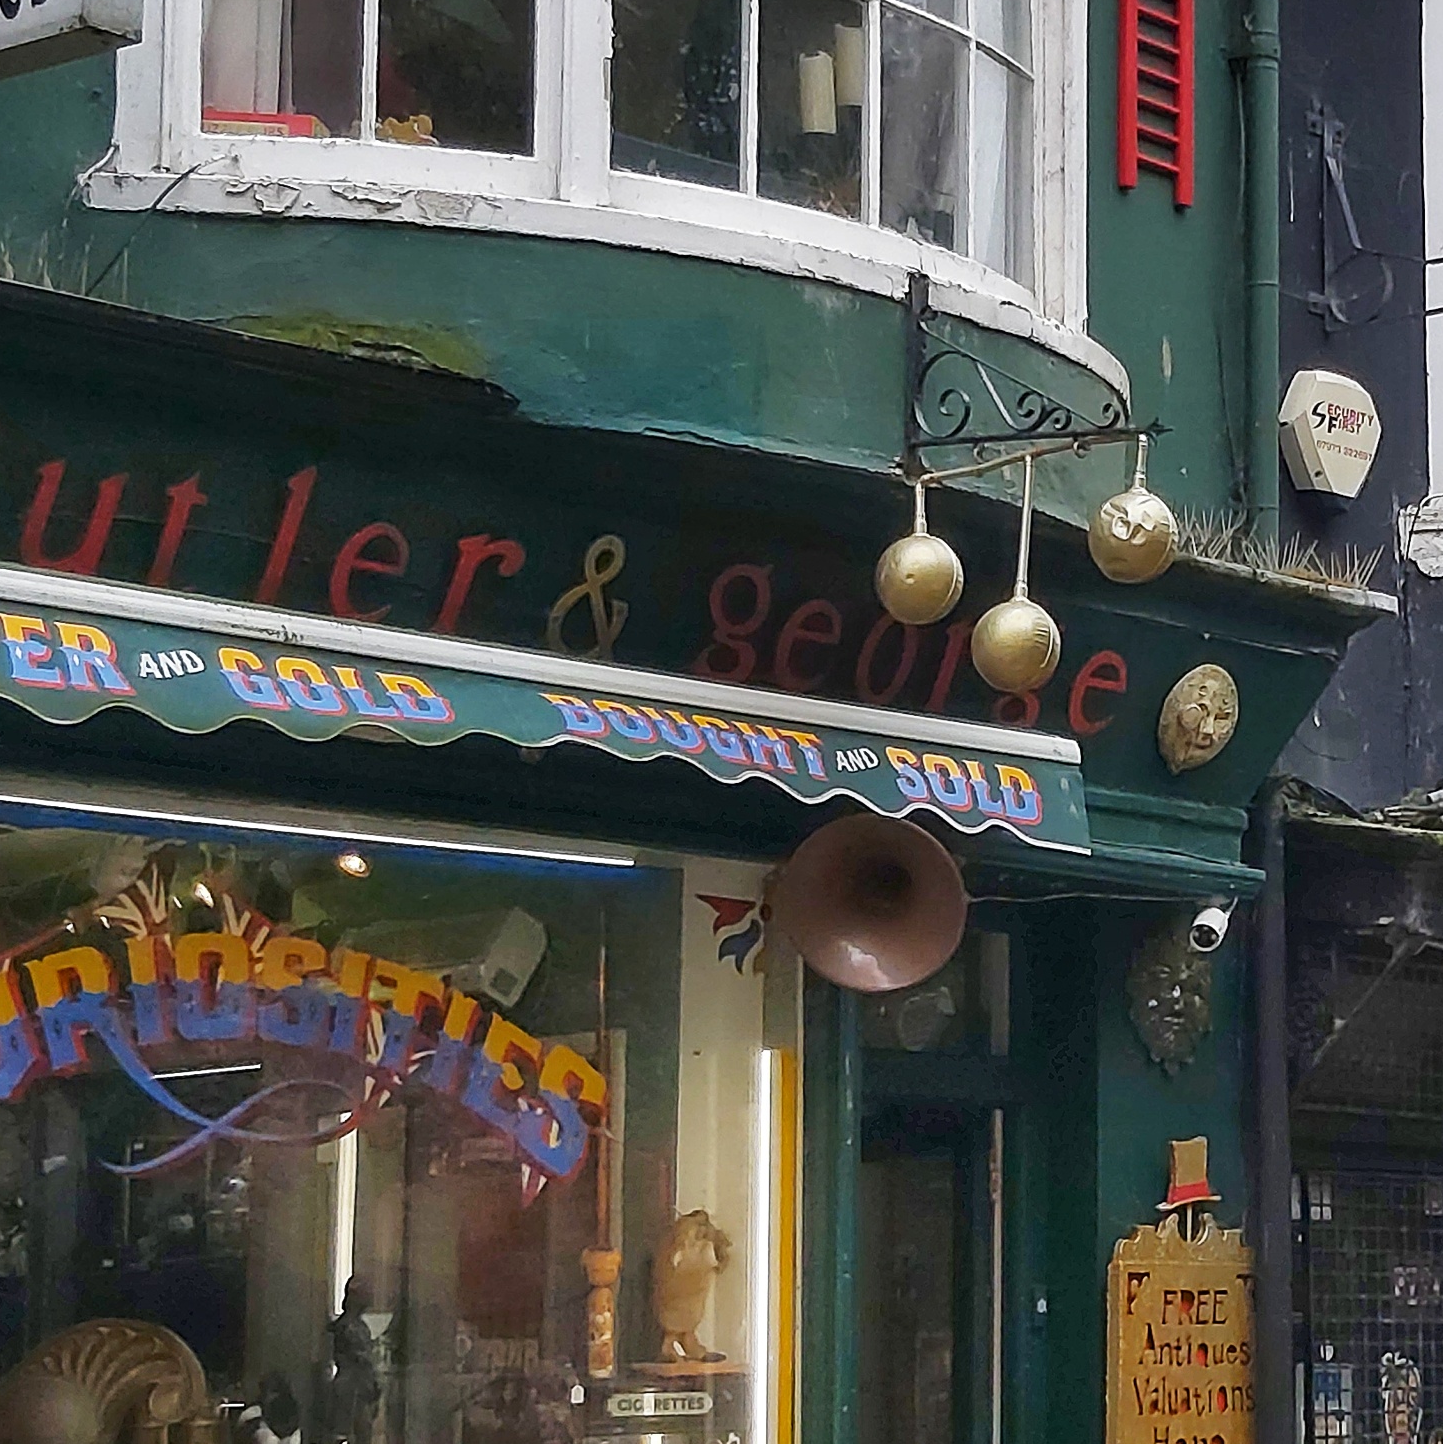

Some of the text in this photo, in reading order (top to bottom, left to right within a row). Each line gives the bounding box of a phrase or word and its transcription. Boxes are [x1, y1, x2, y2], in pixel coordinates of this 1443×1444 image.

[1311, 400, 1375, 430] SECURITY
[547, 533, 629, 660] &
[139, 647, 205, 681] AND
[217, 646, 456, 726] GOLD
[539, 691, 828, 783] BOUGHT
[835, 746, 879, 774] AND
[885, 745, 1043, 828] SOLD
[1161, 1289, 1228, 1325] FREE
[1137, 1322, 1252, 1368] Antiques
[617, 1397, 705, 1413] CIGRETTES
[1132, 1375, 1256, 1417] Valuations
